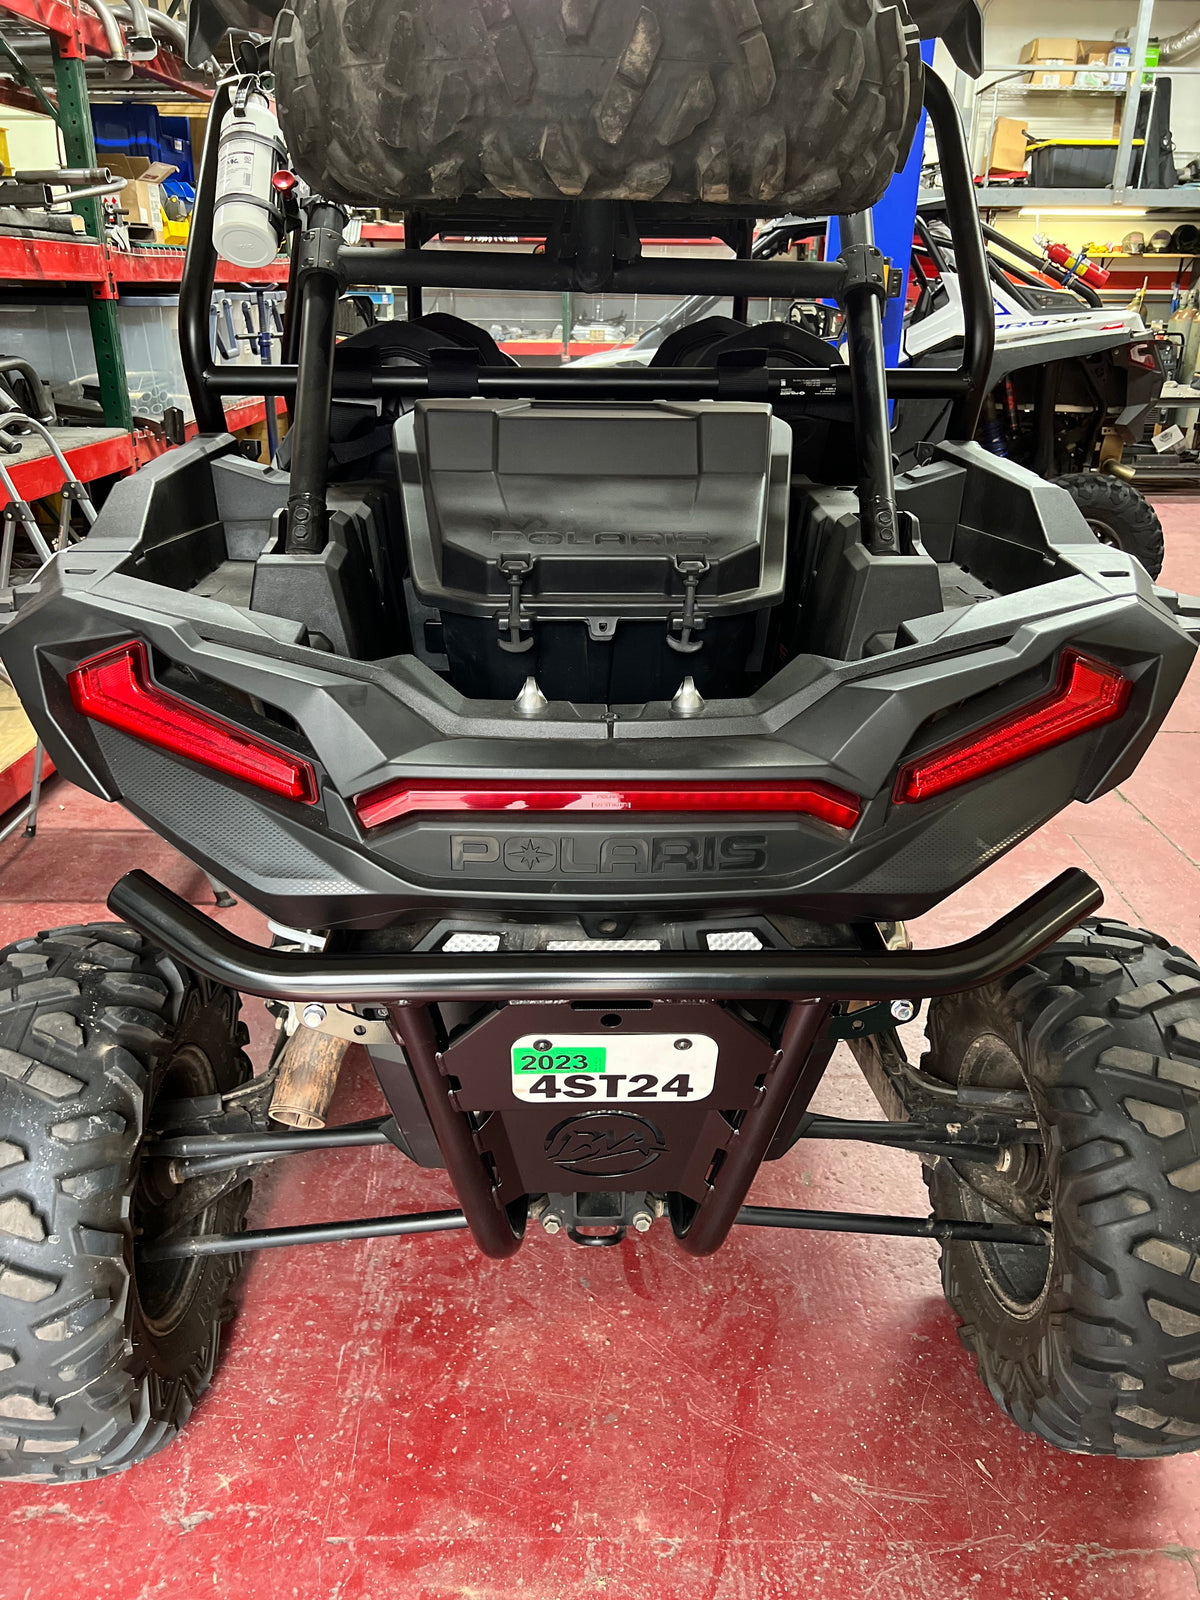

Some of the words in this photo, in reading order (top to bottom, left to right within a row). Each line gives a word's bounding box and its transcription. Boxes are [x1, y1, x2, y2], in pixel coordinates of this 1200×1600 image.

[490, 530, 713, 546] POLARIS
[450, 834, 768, 874] POLARIS
[521, 1054, 589, 1071] 2023
[529, 1073, 694, 1099] 4ST24
